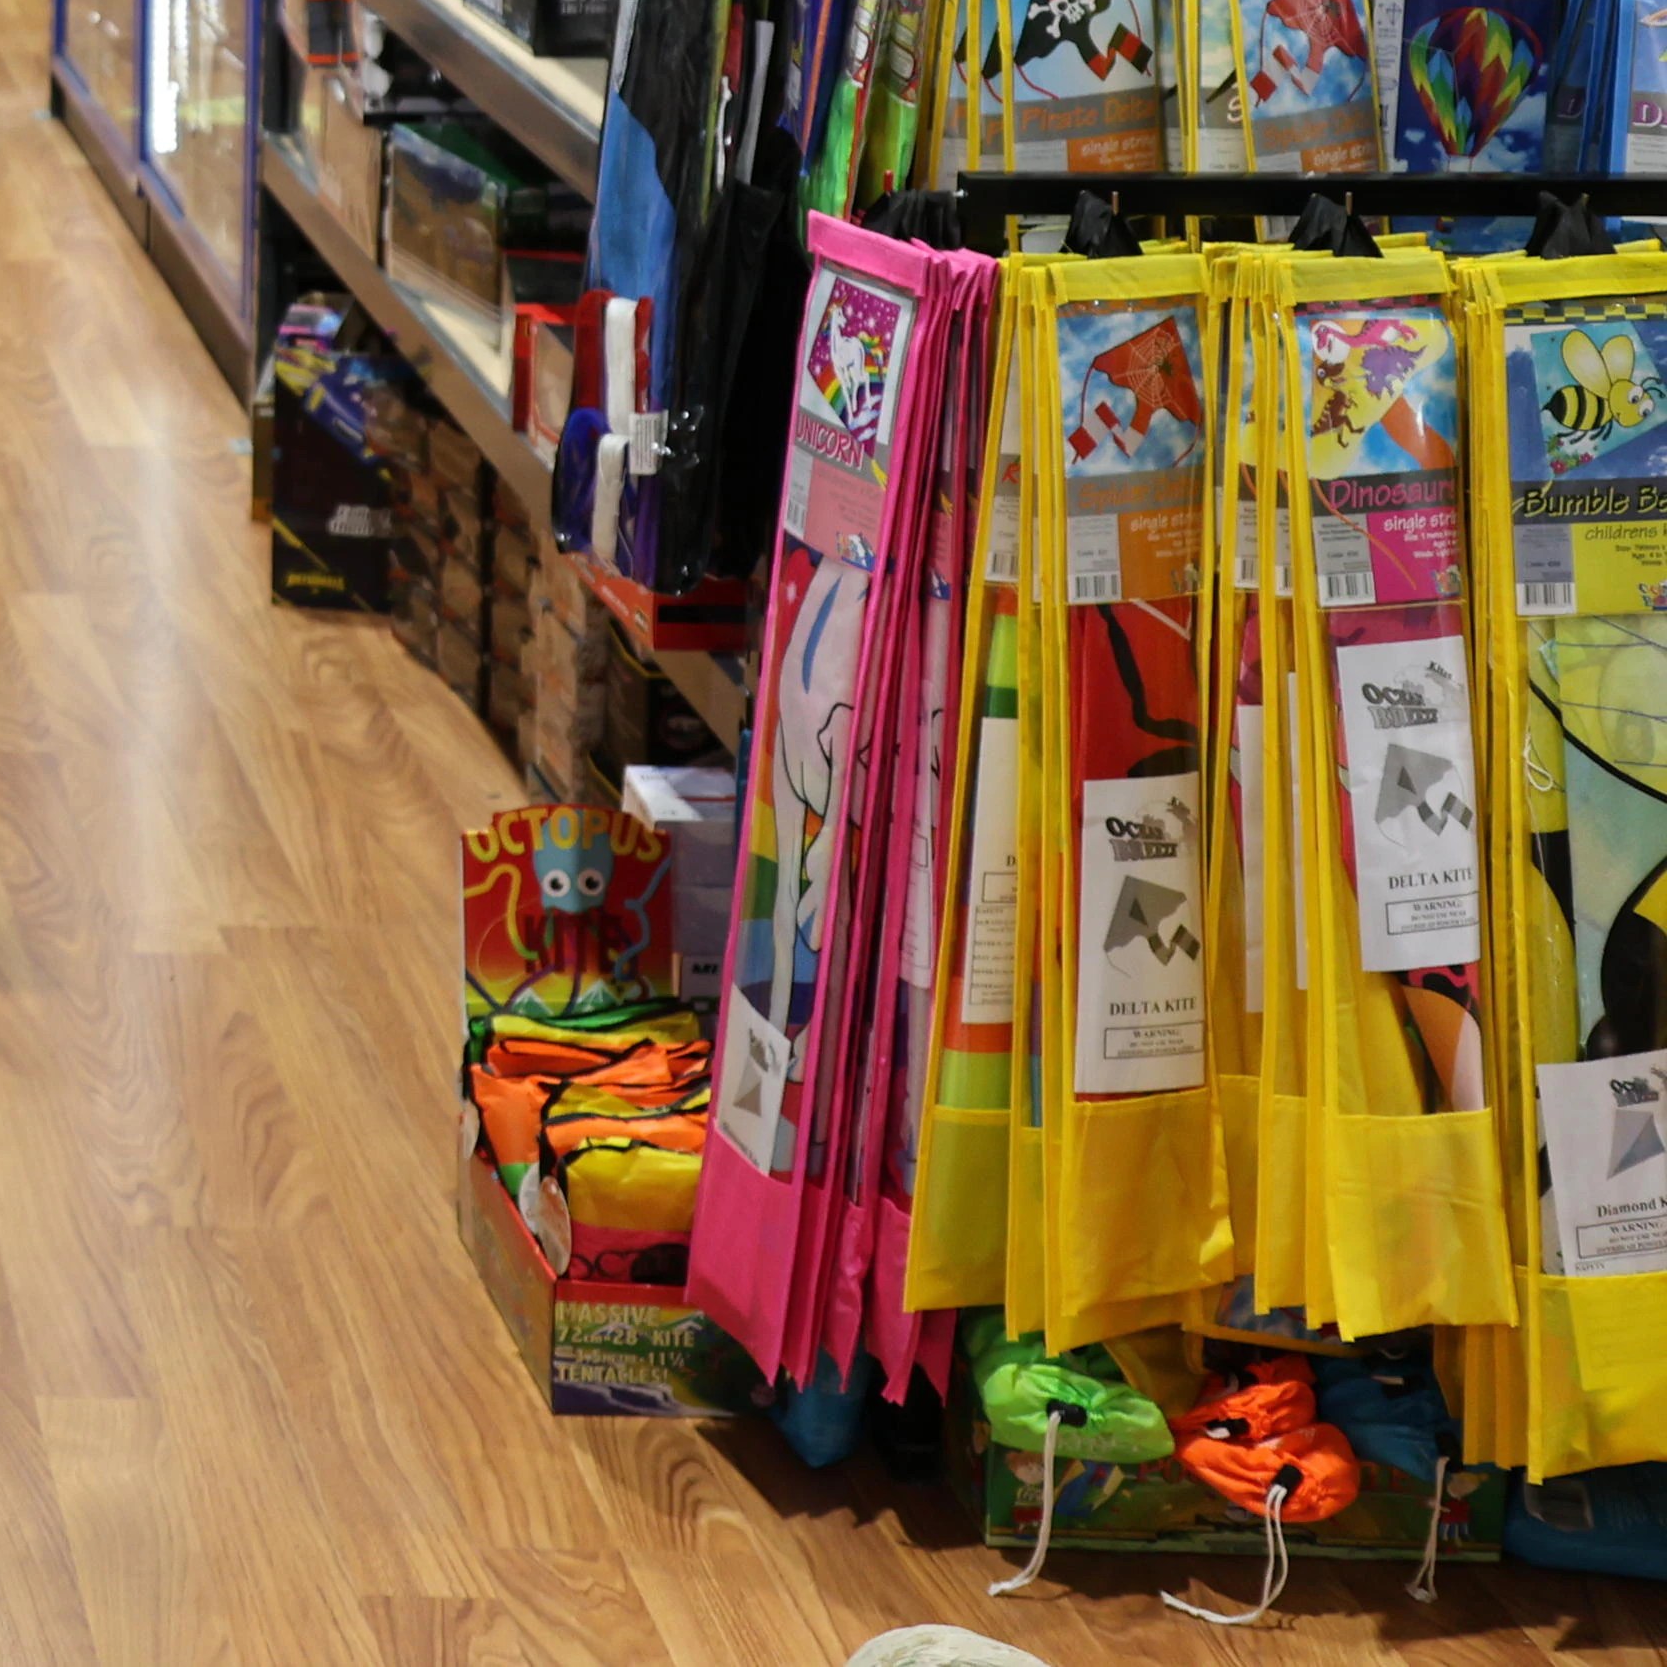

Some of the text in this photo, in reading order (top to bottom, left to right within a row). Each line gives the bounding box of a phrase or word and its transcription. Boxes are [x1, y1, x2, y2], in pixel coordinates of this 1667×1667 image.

[1021, 104, 1098, 132] Pirate
[795, 414, 865, 471] UNICORN
[1524, 486, 1630, 518] Bumble
[1130, 513, 1169, 531] single
[1384, 513, 1427, 534] single
[1585, 525, 1657, 542] childrens
[468, 806, 663, 862] OCTOPUS
[1389, 867, 1473, 890] DELTA KITE
[1109, 996, 1198, 1017] DELTA KITE
[1597, 1199, 1656, 1218] Diamond
[556, 1301, 660, 1326] MASSIVE
[652, 1330, 695, 1347] KITE
